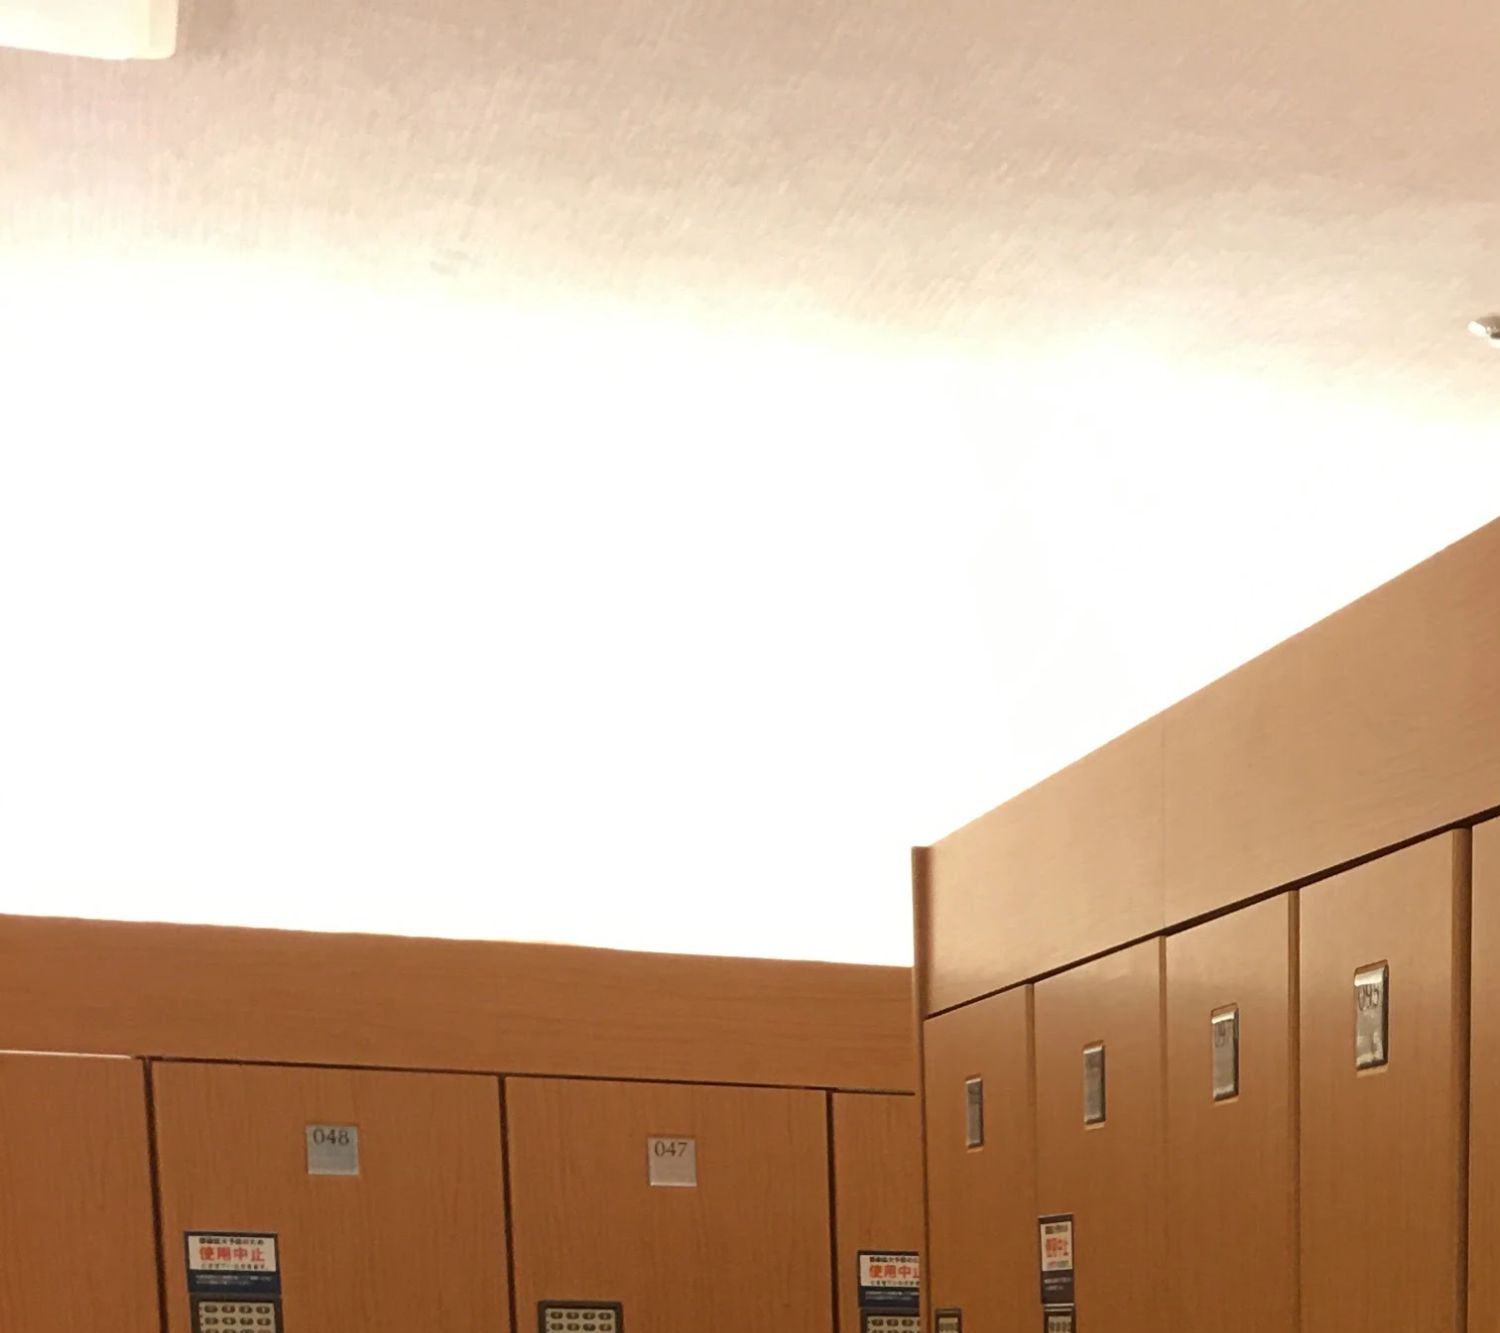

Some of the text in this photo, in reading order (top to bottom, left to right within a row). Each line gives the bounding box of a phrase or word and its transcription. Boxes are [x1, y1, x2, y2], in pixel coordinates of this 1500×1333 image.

[313, 1129, 350, 1145] 048
[654, 1140, 688, 1157] 047
[199, 1246, 265, 1262] 使用中止
